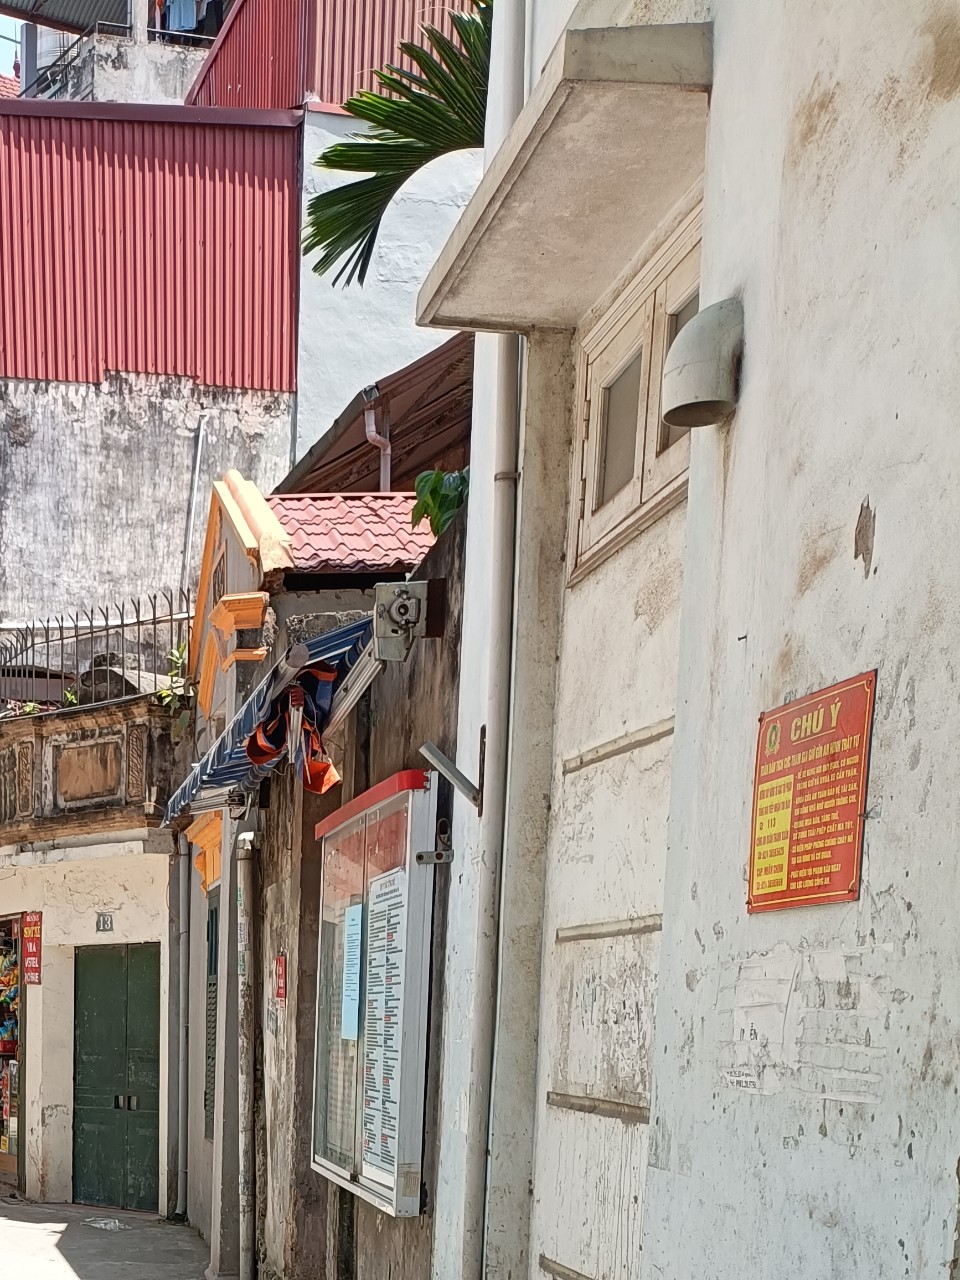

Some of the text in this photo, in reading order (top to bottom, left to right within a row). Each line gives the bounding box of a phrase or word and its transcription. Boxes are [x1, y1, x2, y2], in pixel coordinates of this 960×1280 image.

[790, 696, 842, 741] CHÚ Ý
[99, 915, 111, 930] 13
